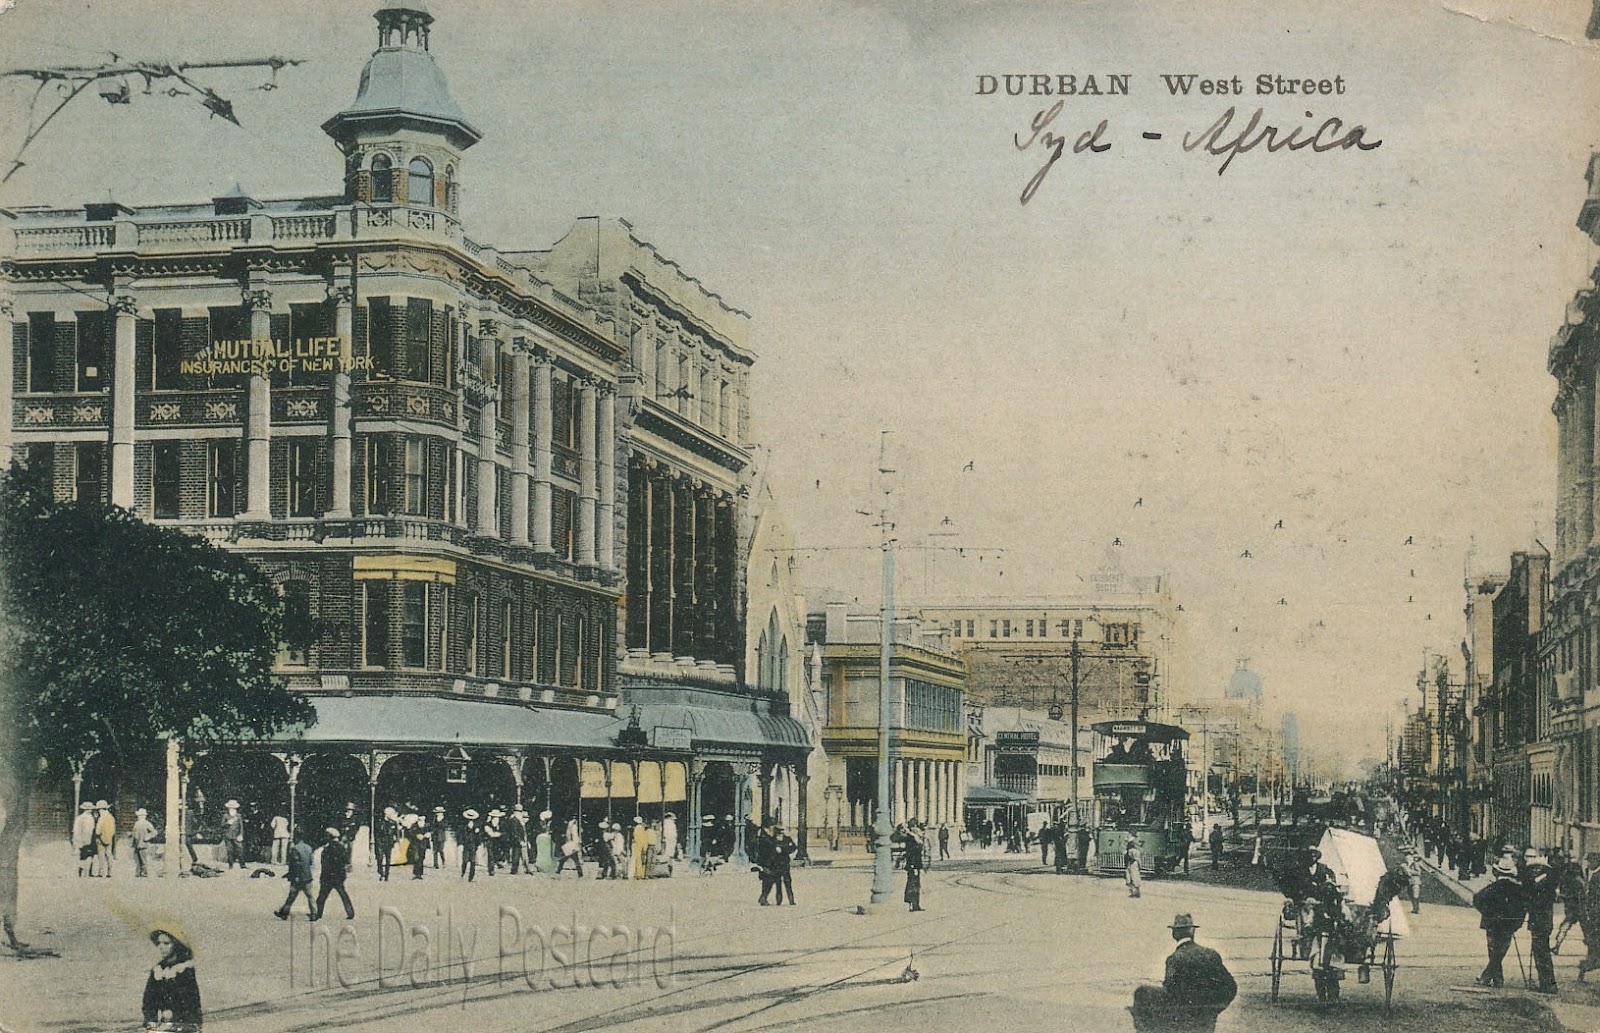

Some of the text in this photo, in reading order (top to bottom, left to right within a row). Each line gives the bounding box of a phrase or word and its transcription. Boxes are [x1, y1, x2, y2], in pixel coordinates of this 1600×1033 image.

[1182, 105, 1383, 176] Africa
[213, 339, 290, 360] MUTUAL
[295, 337, 340, 358] LIFE
[180, 359, 261, 375] INSURANCE
[279, 358, 299, 373] OF
[302, 357, 333, 372] NEW
[337, 355, 375, 372] YORK
[998, 732, 1038, 741] CENTRAL HOTEL
